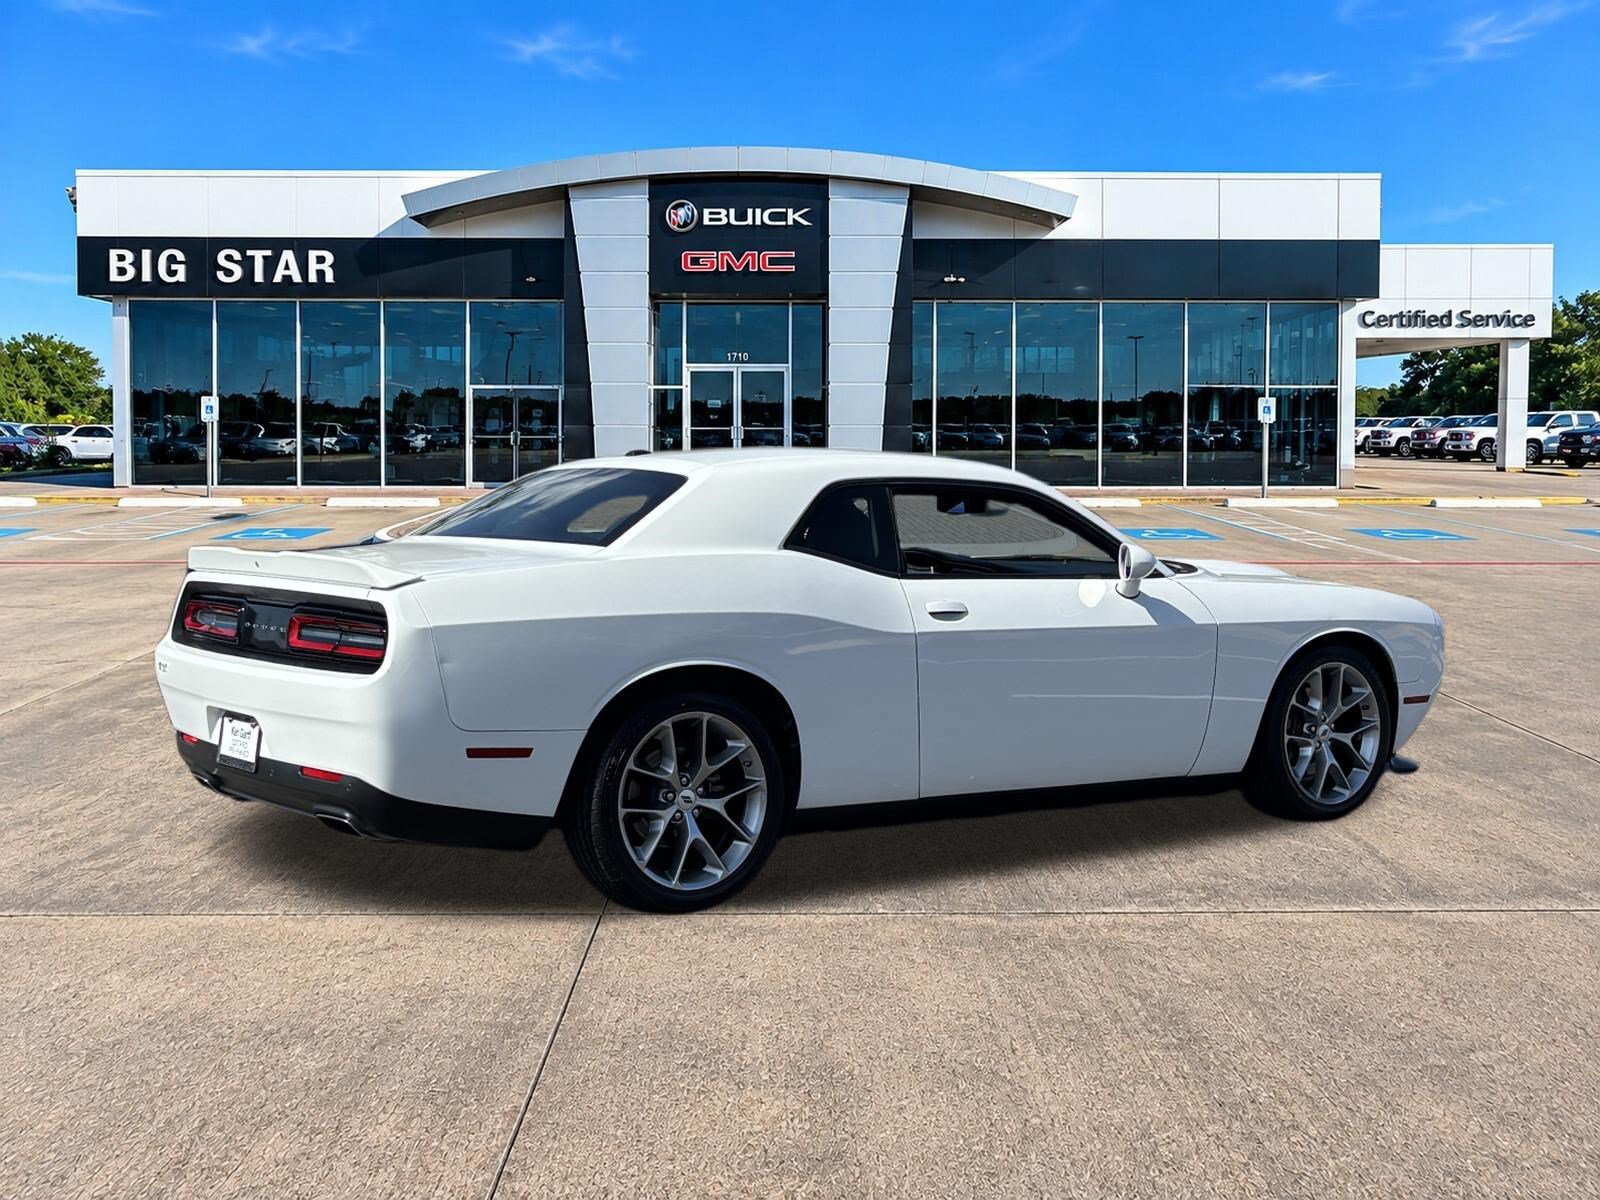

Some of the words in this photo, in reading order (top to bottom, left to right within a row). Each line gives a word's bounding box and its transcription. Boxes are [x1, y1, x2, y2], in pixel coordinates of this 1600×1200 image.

[702, 208, 813, 226] BUICK
[108, 248, 187, 283] BIG
[216, 248, 336, 284] STAR
[681, 251, 796, 272] GMC
[1360, 309, 1453, 329] Certified
[1456, 309, 1536, 328] Service
[726, 352, 749, 361] 1710
